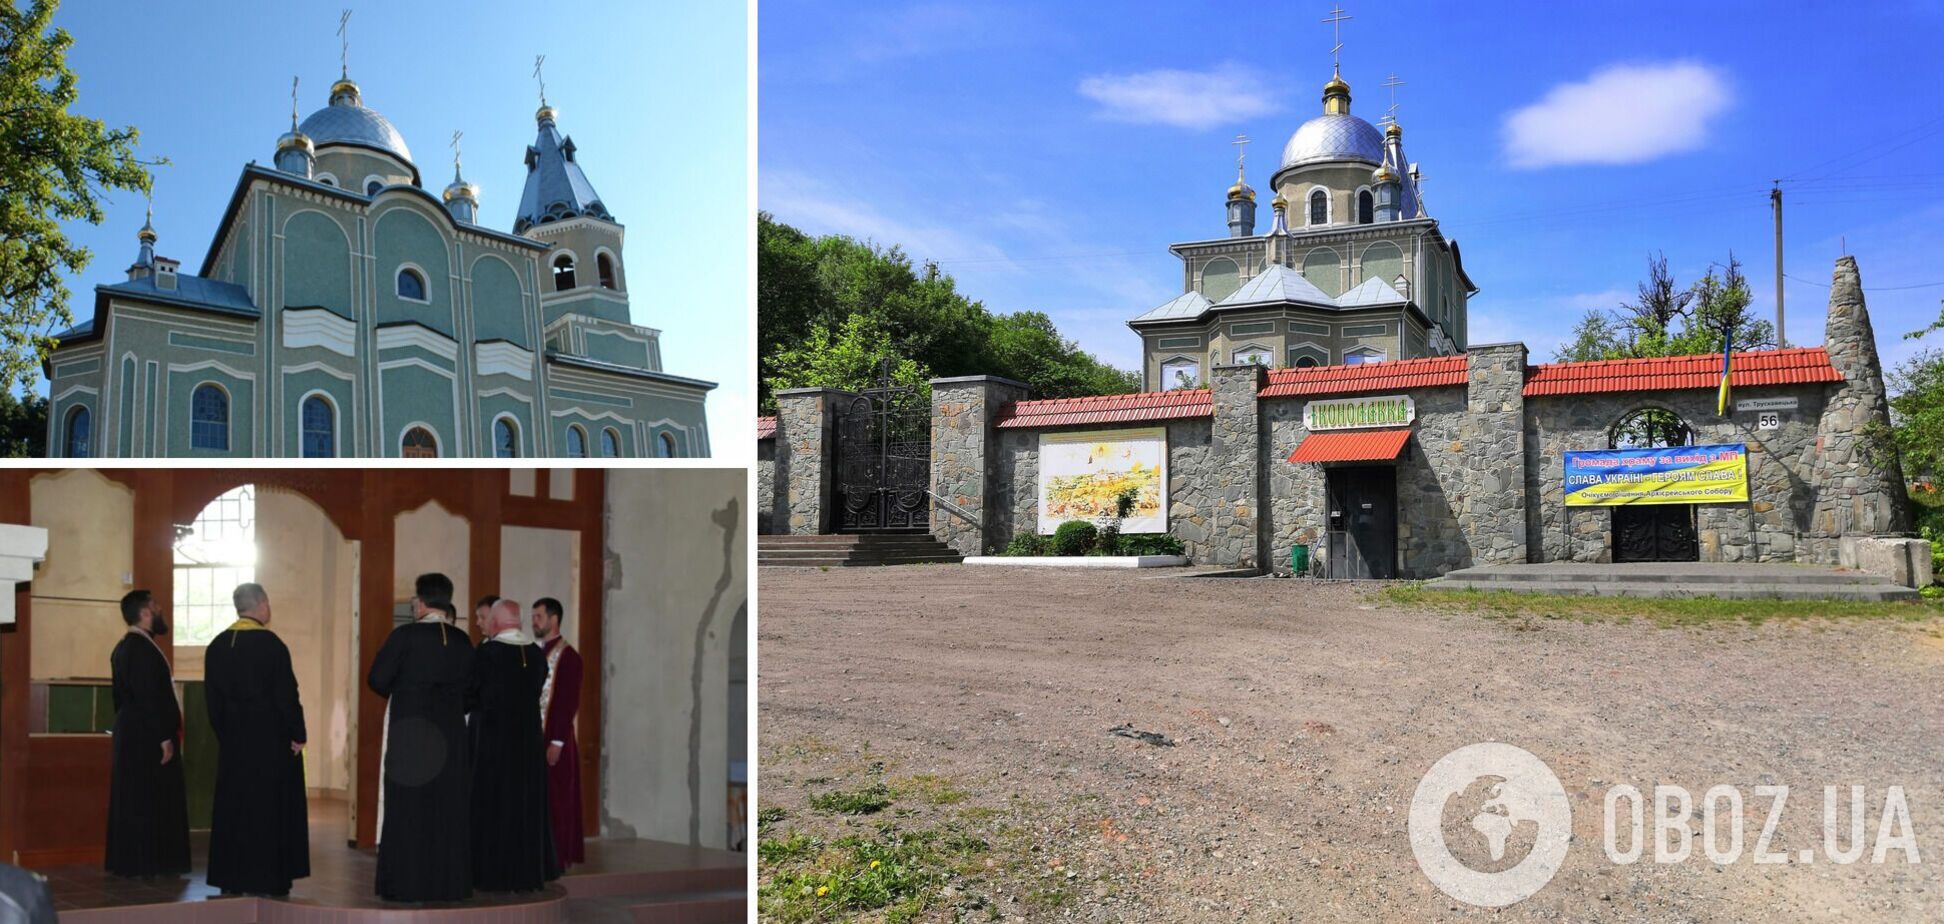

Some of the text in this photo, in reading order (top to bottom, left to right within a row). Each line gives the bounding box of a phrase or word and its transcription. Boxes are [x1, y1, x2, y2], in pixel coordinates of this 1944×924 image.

[1761, 415, 1778, 427] 56
[1571, 457, 1619, 469] Громада
[1621, 456, 1657, 467] храму
[1659, 455, 1672, 464] за
[1674, 453, 1708, 464] вихід
[1719, 450, 1739, 463] МП
[1568, 475, 1603, 485] СЛАВА
[1605, 472, 1643, 483] УКРАЇНІ
[1651, 471, 1696, 483] ГЕРОЯМ
[1698, 469, 1736, 481] СЛАВА
